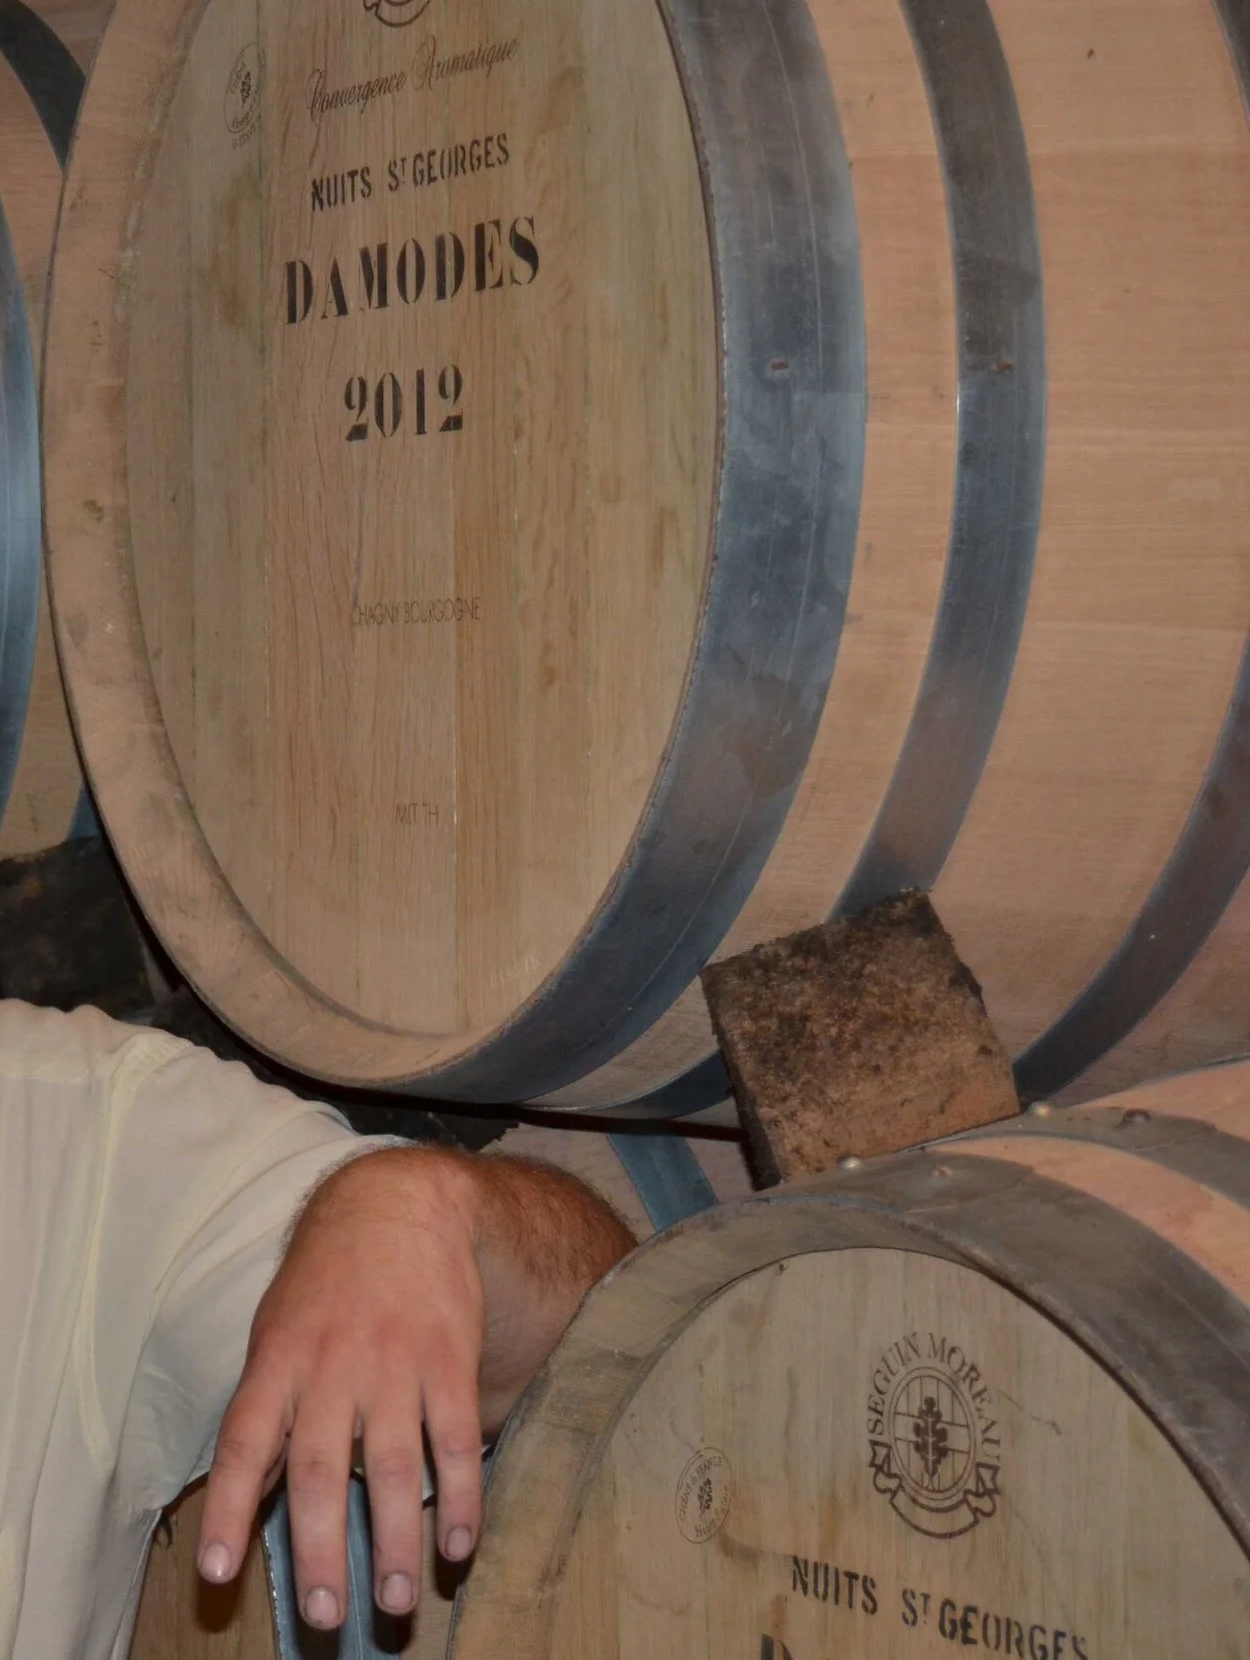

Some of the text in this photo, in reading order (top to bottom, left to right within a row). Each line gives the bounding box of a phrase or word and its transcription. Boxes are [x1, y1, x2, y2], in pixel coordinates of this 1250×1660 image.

[311, 166, 372, 212] NUITS
[412, 132, 510, 188] GEORGES
[284, 215, 540, 325] DAMODES
[344, 364, 464, 442] 2012
[866, 1331, 1001, 1462] SEGUIN MOREAU
[791, 1554, 879, 1616] NUITS
[937, 1597, 1089, 1660] GEORGES
